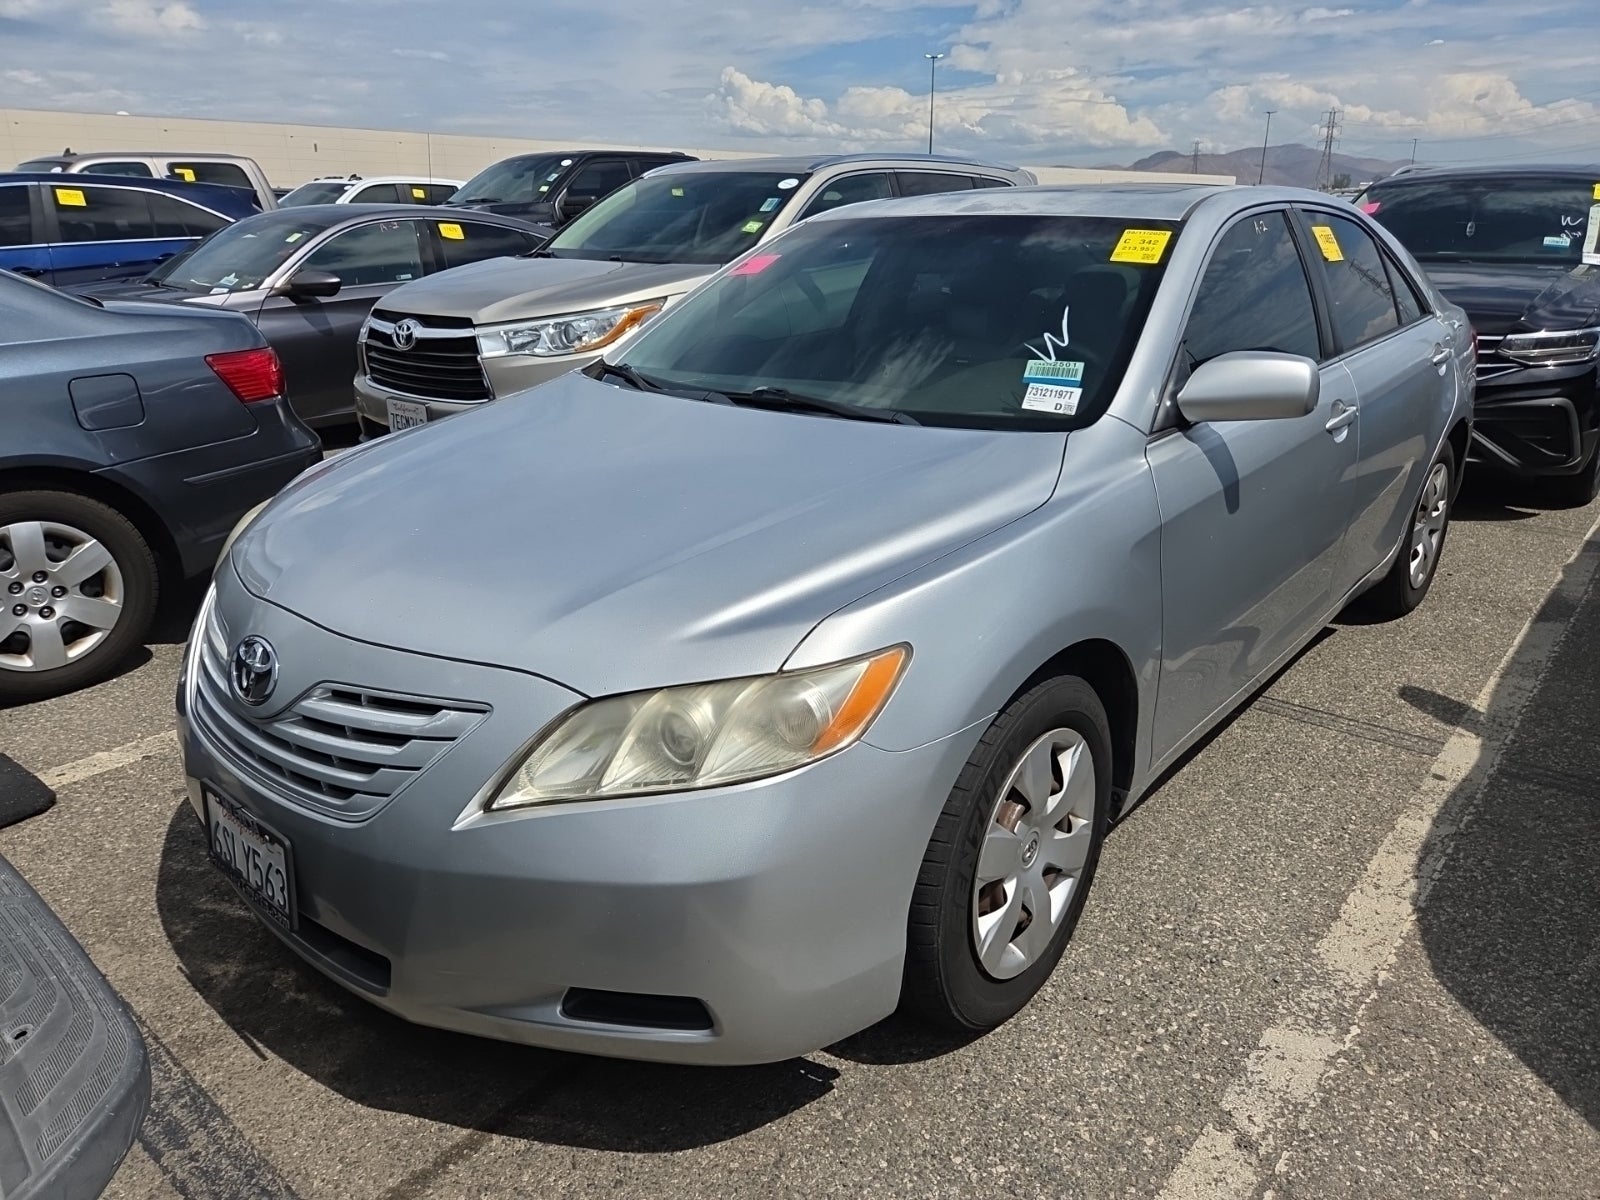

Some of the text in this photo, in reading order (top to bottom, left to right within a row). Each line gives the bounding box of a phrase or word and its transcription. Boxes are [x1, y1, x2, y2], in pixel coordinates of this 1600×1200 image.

[1028, 387, 1074, 400] 73121197T
[1054, 403, 1062, 411] D
[214, 821, 286, 910] 6SLY563
